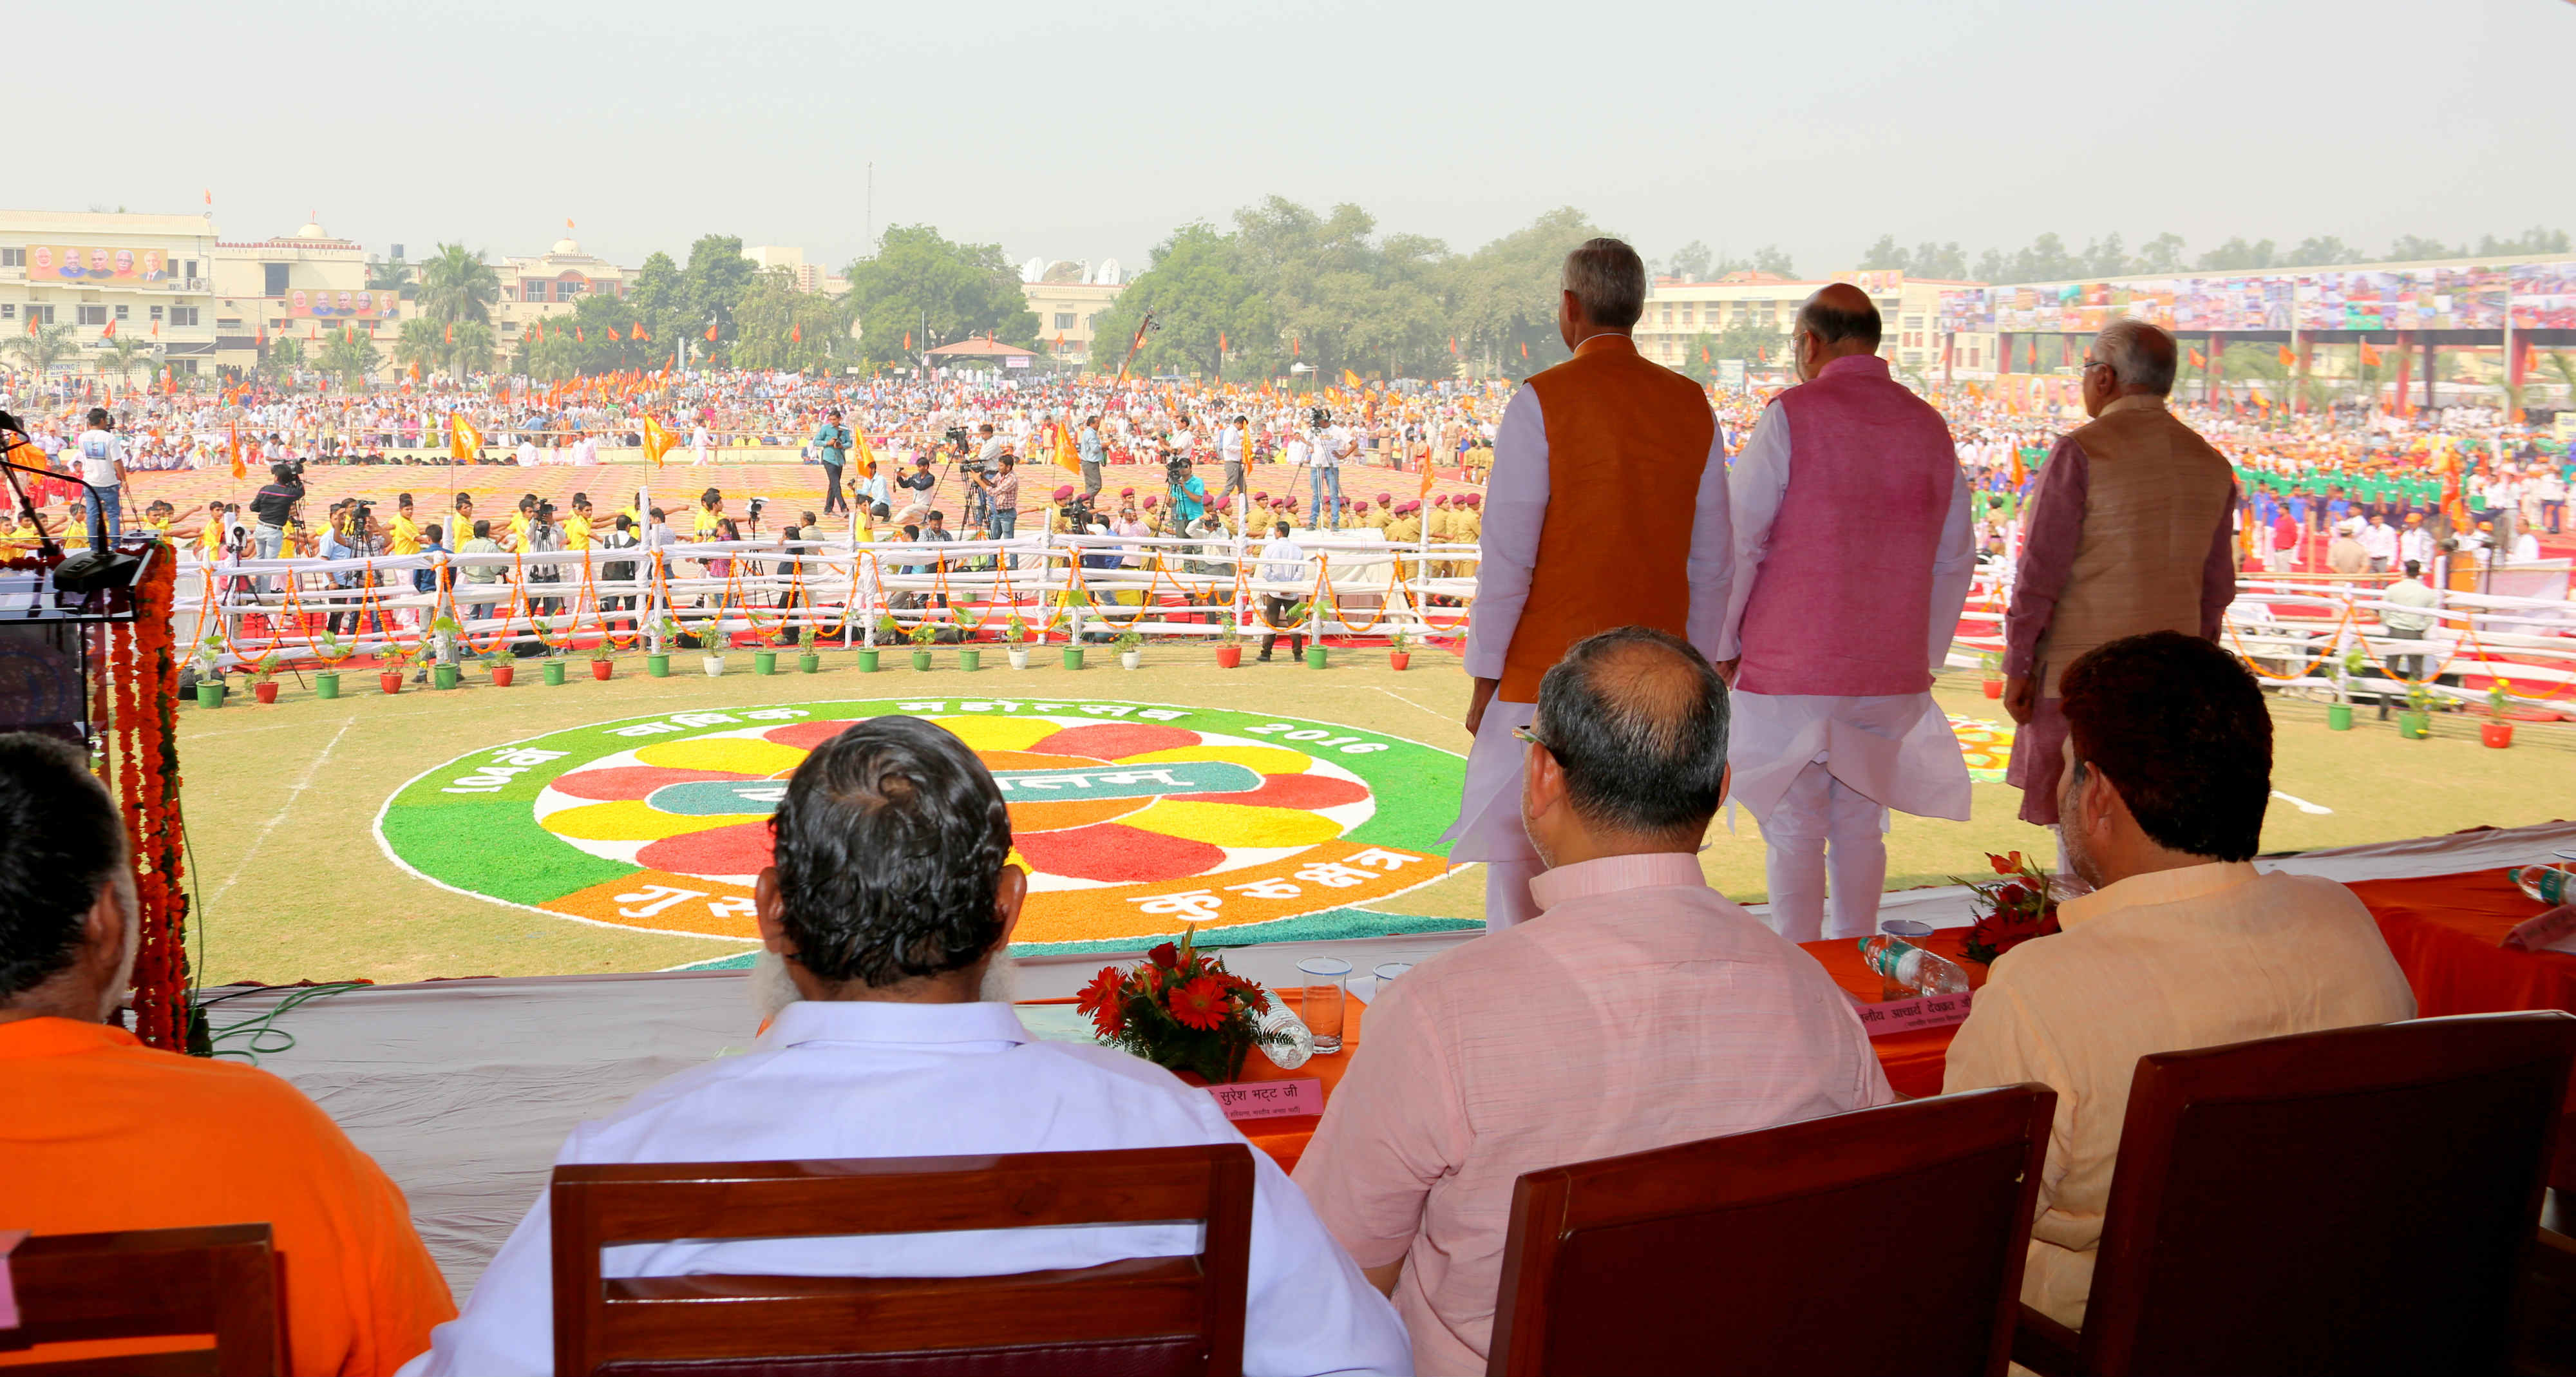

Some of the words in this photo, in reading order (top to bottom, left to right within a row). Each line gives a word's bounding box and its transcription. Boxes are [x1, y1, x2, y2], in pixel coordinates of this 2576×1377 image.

[895, 699, 1193, 721] महोत्सव
[1244, 723, 1389, 754] 2016
[1126, 848, 1423, 921] कुरुक्षेत्र
[1220, 1087, 1247, 1105] सुरेश
[1252, 1088, 1278, 1102] भट्ट
[1283, 1084, 1298, 1097] जी
